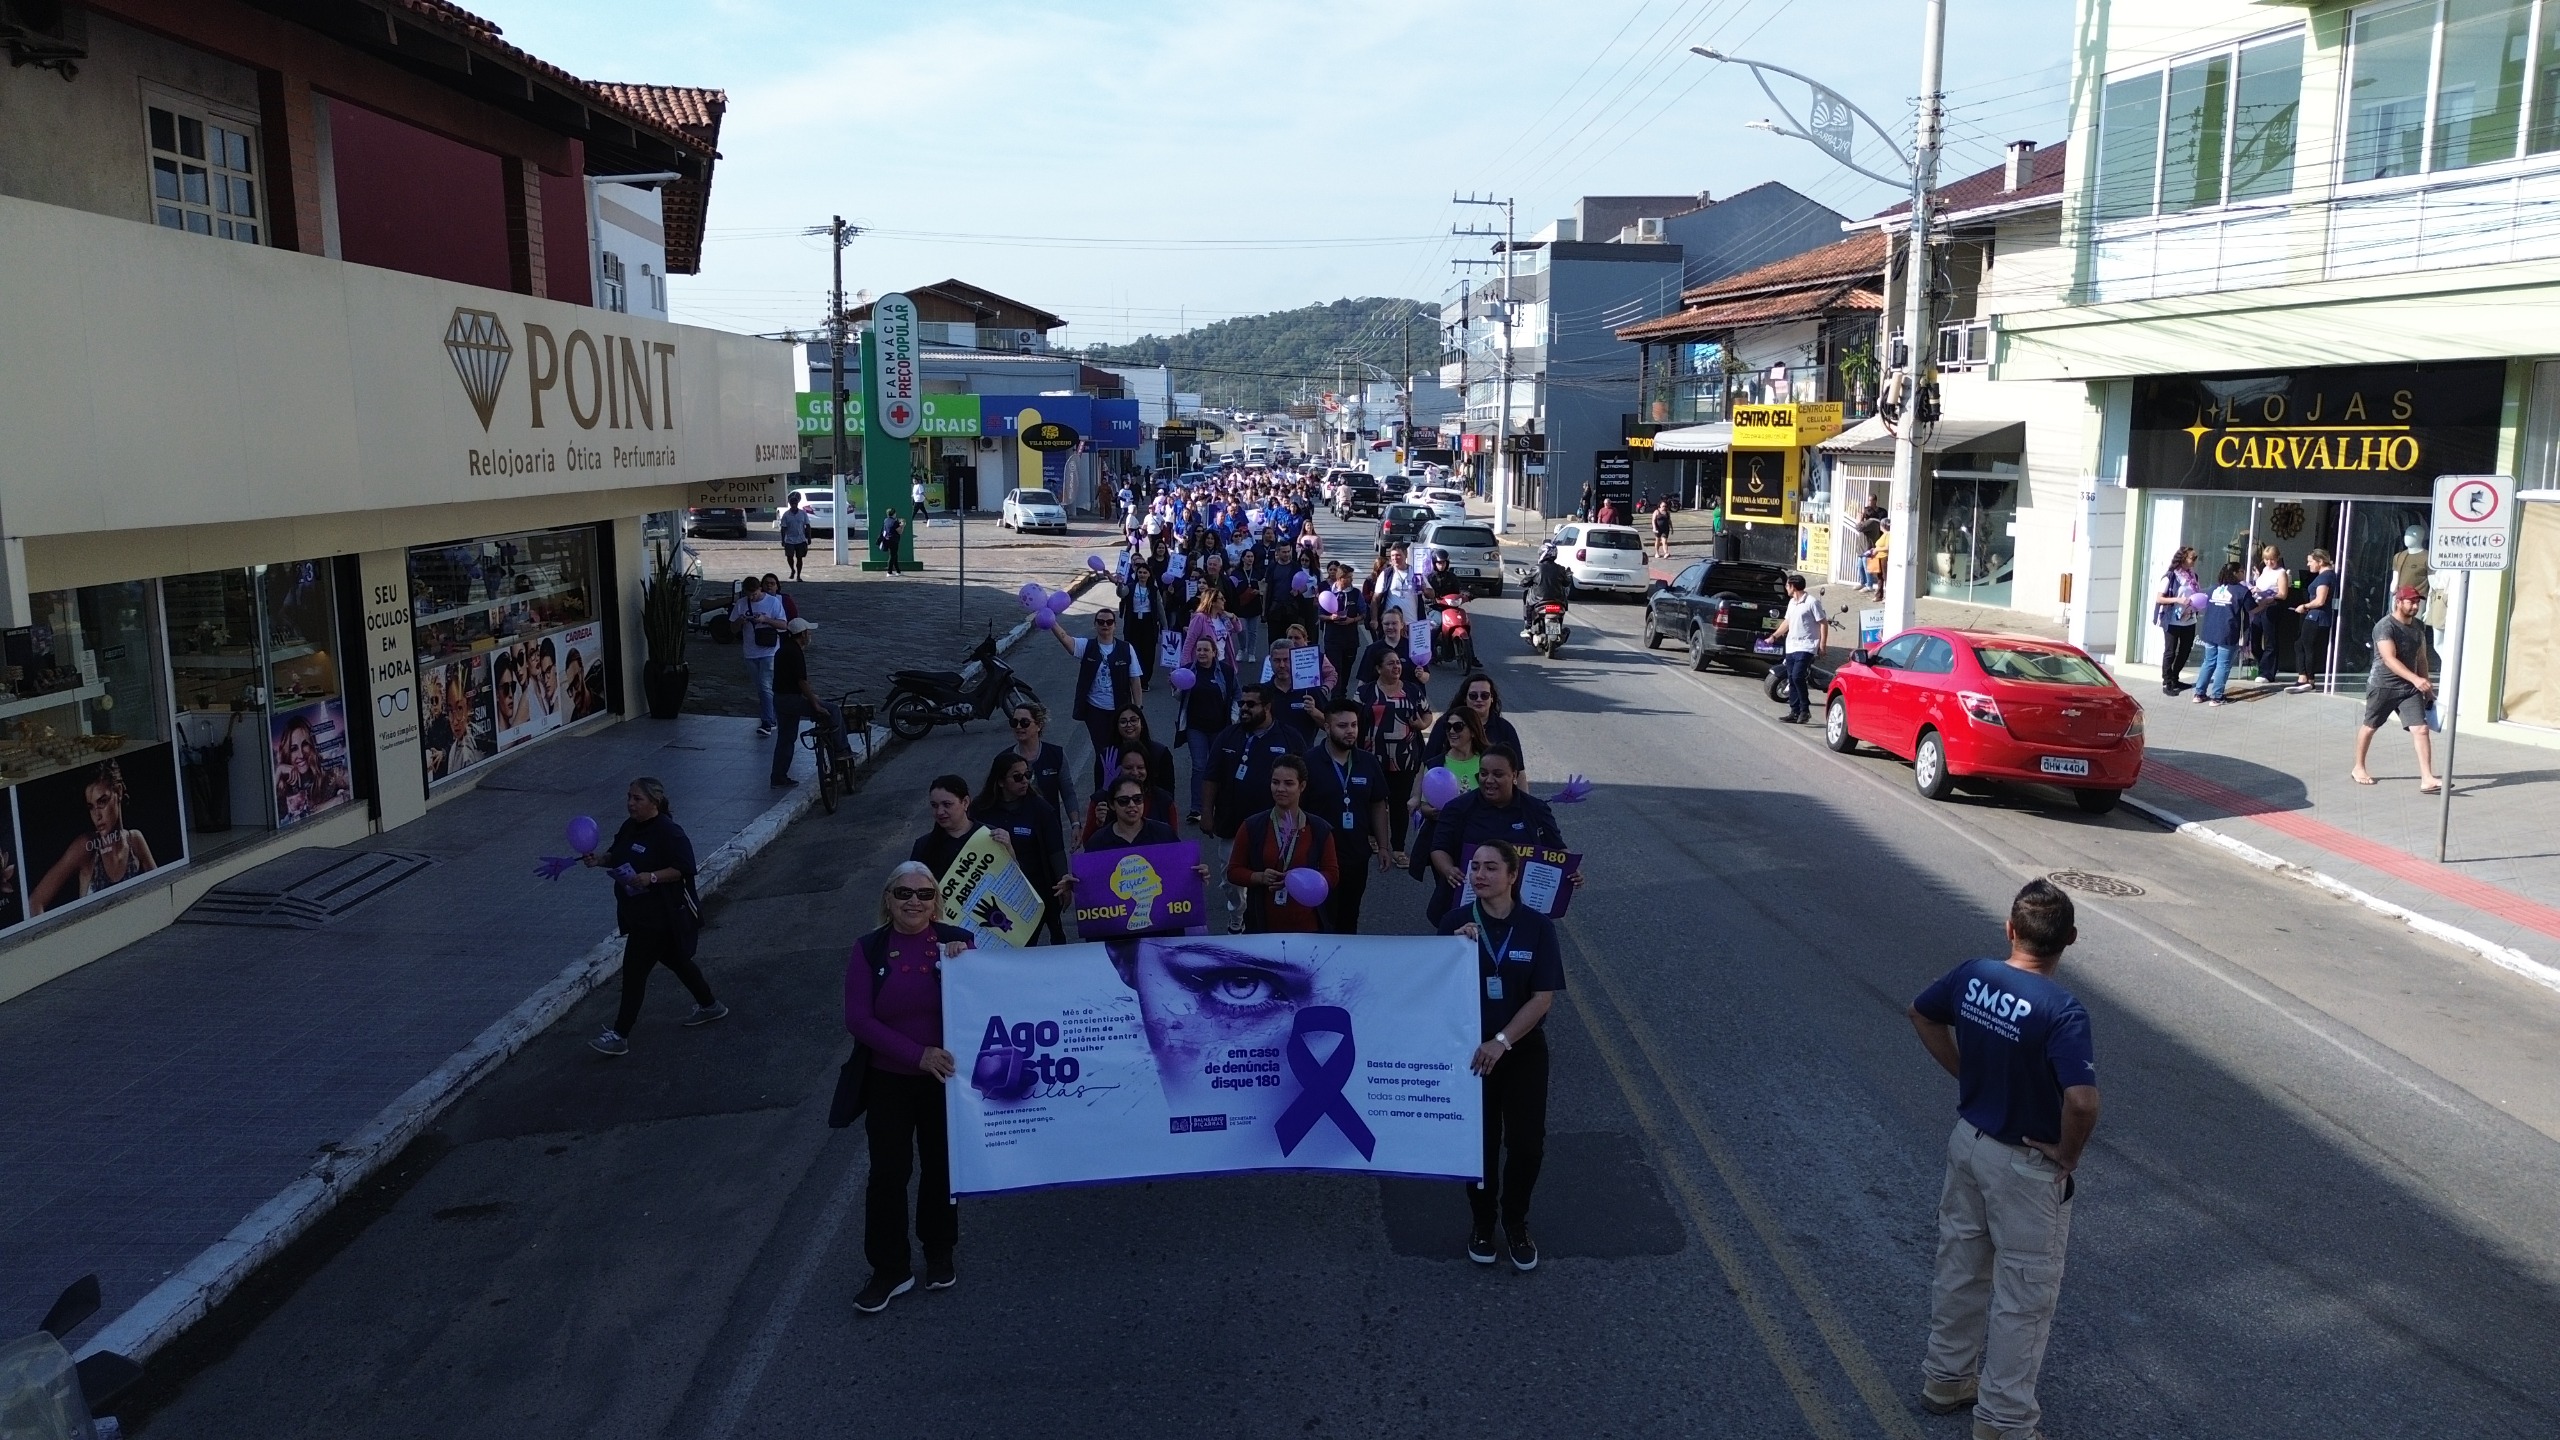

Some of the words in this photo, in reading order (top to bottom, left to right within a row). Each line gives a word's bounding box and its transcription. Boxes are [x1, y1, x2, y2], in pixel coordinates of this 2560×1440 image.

[881, 304, 897, 398] FARMÁCIA
[895, 304, 913, 398] PREÇOPOPULAR
[523, 322, 676, 431] POINT
[809, 400, 862, 414] GRO
[1798, 404, 1824, 414] CENTRO
[1825, 403, 1840, 413] CELL
[2226, 390, 2413, 423] LOJAS
[922, 418, 977, 433] URAIS
[1003, 416, 1018, 430] TI
[1112, 420, 1132, 430] TIM
[1734, 411, 1770, 427] CENTRO
[1771, 410, 1794, 427] CELL
[468, 449, 555, 478] Relojoaria
[567, 440, 601, 471] Ótica
[613, 446, 676, 469] Perfumaria
[2215, 435, 2419, 471] CARVALHO
[728, 482, 767, 492] POINT
[700, 493, 775, 504] Perfumaria
[2080, 491, 2096, 501] 336
[374, 584, 397, 605] SEU
[367, 608, 409, 631] ÓCULOS
[565, 627, 592, 643] CARRERA
[382, 637, 397, 651] EM
[371, 667, 375, 684] 1
[379, 659, 412, 682] HORA
[1541, 850, 1567, 864] 180
[955, 852, 977, 878] NÃO
[955, 853, 995, 905] ABUSIVO
[1077, 904, 1128, 920] DISQUE
[1166, 900, 1192, 914] 180
[1965, 978, 2031, 1022] SMSP
[1062, 1012, 1136, 1025] conscientização
[1960, 1009, 1993, 1031] SEGURANÇA
[1961, 1001, 1991, 1021] SECRETARIA
[1991, 1015, 2021, 1034] MUNICIPAL
[979, 1015, 1060, 1060] Ago
[1063, 1028, 1083, 1036] pelo
[1084, 1025, 1100, 1033] fim
[1063, 1034, 1106, 1044] violência
[1108, 1033, 1138, 1041] contra
[1071, 1044, 1104, 1053] mulher
[1227, 1049, 1248, 1058] em
[1249, 1048, 1280, 1058] caso
[1204, 1062, 1221, 1074] de
[1222, 1060, 1280, 1073] denúncia
[1367, 1060, 1393, 1068] Basta
[1394, 1061, 1406, 1069] de
[1407, 1062, 1453, 1071] agressão!
[1211, 1076, 1254, 1091] disque
[1255, 1074, 1280, 1087] 180
[1367, 1076, 1400, 1085] Vamos
[1401, 1077, 1441, 1088] proteger
[1367, 1092, 1392, 1101] todas
[1394, 1094, 1406, 1102] as
[1407, 1094, 1451, 1103] mulheres
[1367, 1109, 1388, 1117] com
[1390, 1110, 1415, 1118] amor
[1423, 1112, 1464, 1121] empatia.
